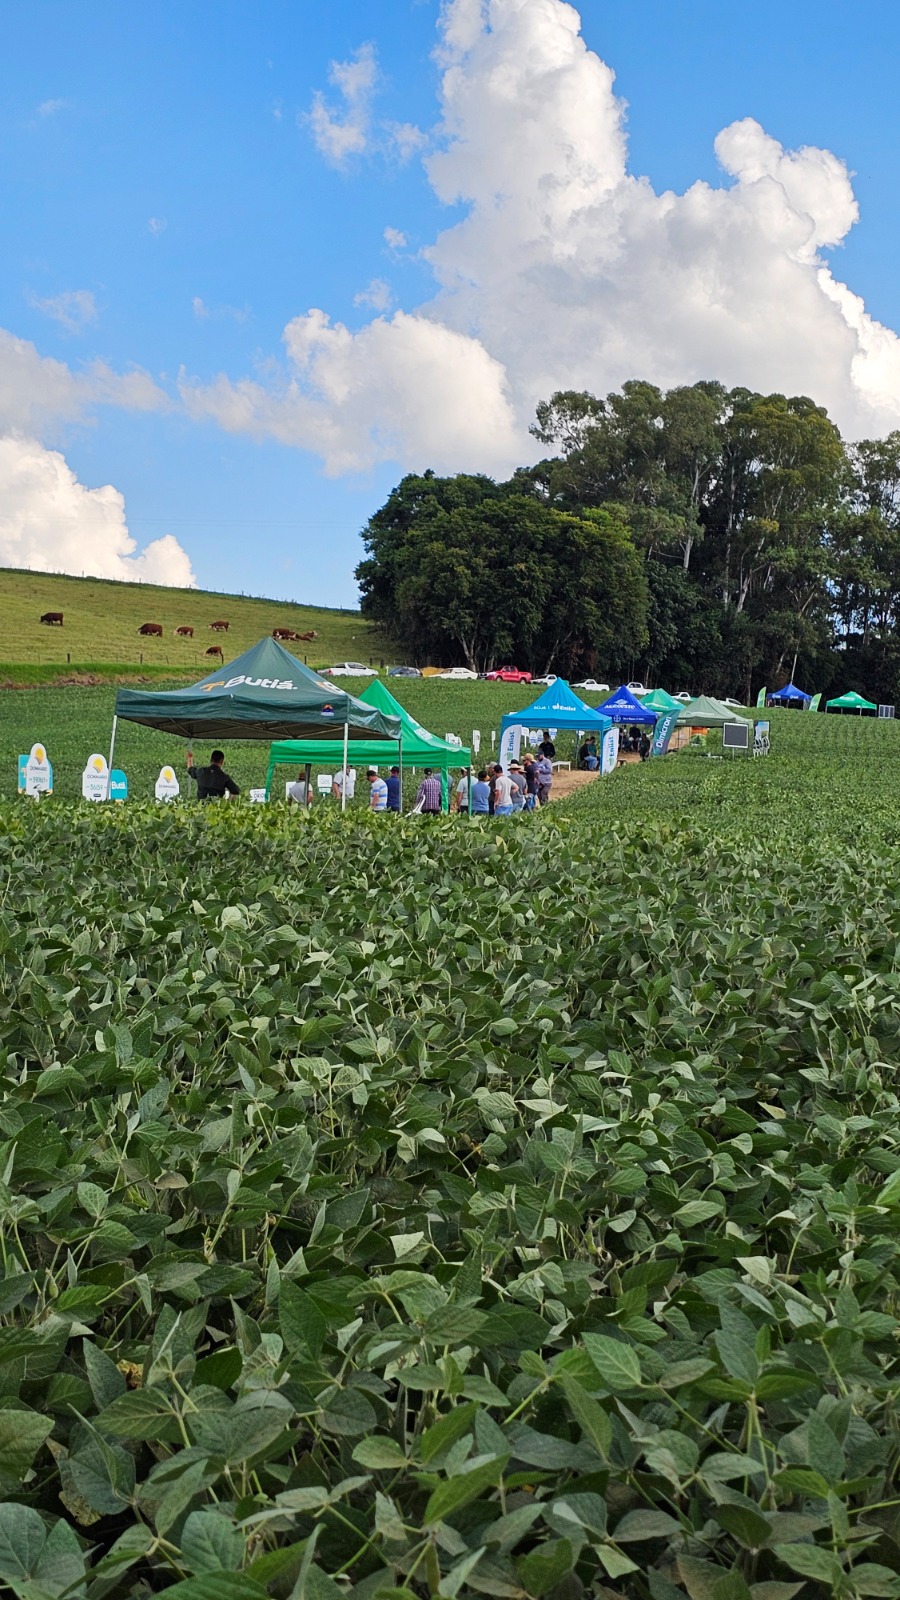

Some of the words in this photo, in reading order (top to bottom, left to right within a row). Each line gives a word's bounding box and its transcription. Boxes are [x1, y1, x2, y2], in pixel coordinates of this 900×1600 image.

[224, 675, 298, 690] Butiá.
[507, 731, 515, 752] Enlist
[656, 716, 672, 748] Dimicron
